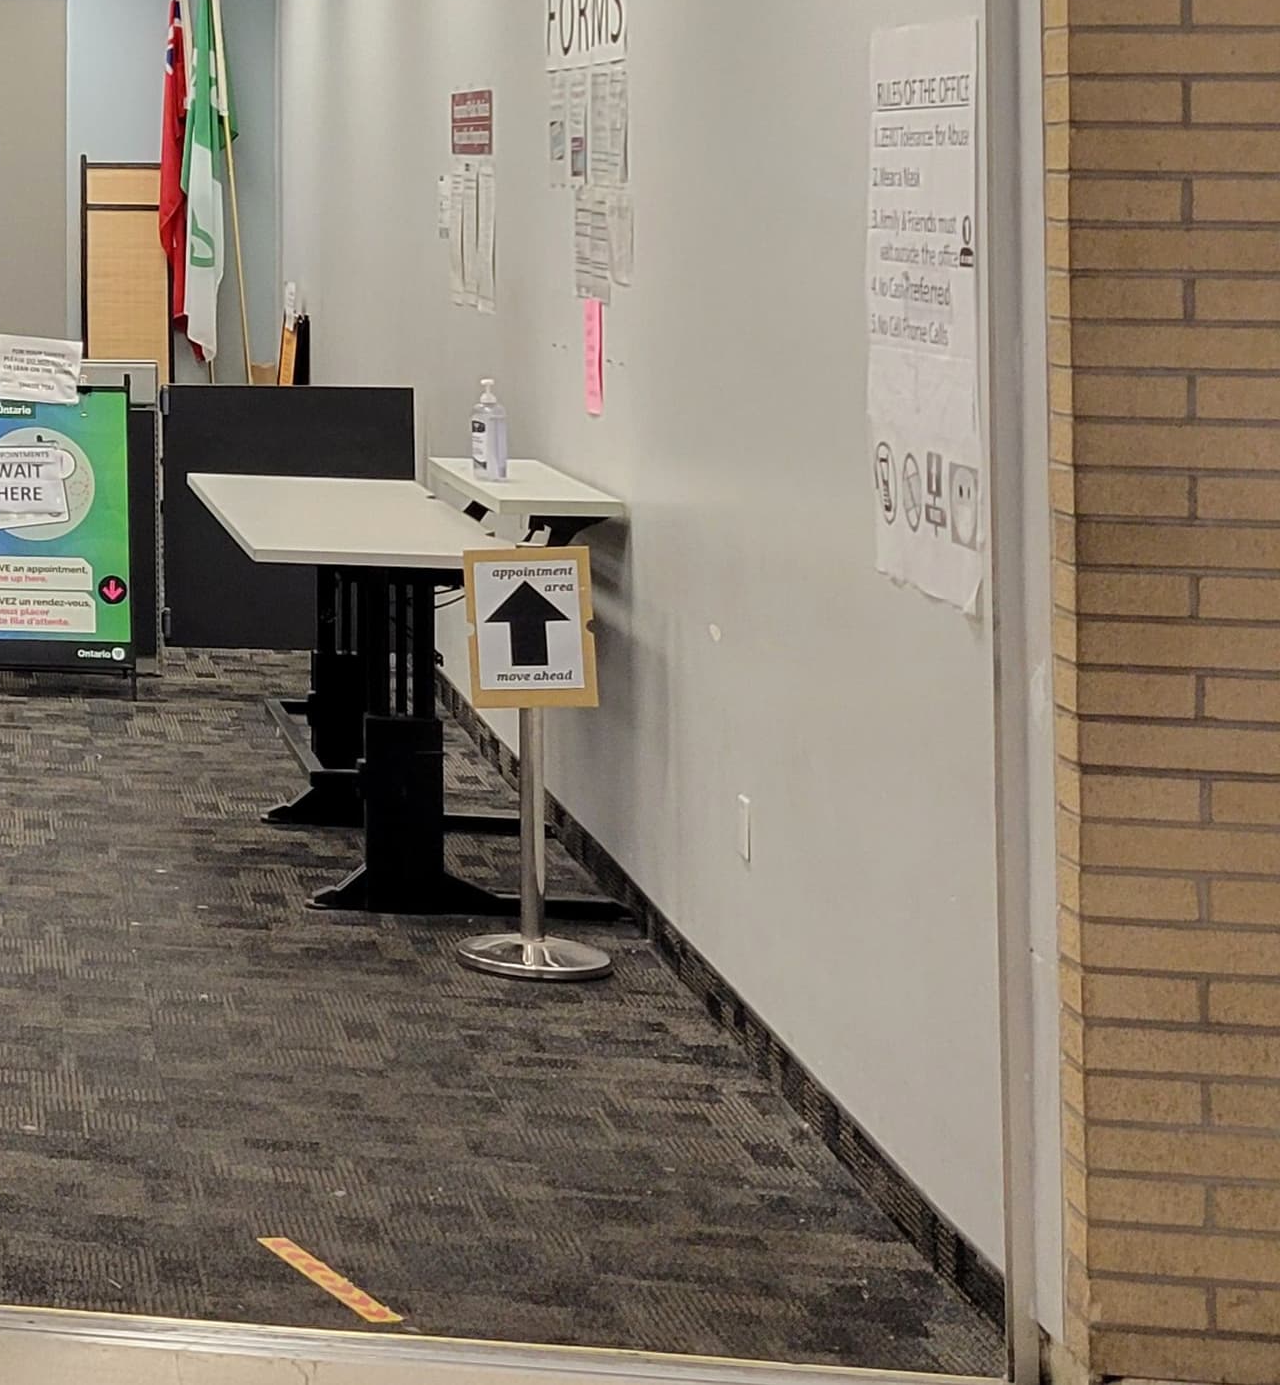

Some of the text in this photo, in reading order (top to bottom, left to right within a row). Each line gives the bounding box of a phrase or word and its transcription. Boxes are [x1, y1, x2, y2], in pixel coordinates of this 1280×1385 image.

[877, 75, 970, 106] RULES OF THE OFFICE
[27, 565, 88, 575] appointment,
[492, 567, 573, 580] appointment
[544, 583, 574, 592] area
[33, 598, 91, 607] rendez-vous,
[77, 649, 111, 659] Ontario
[497, 670, 572, 681] move ahead
